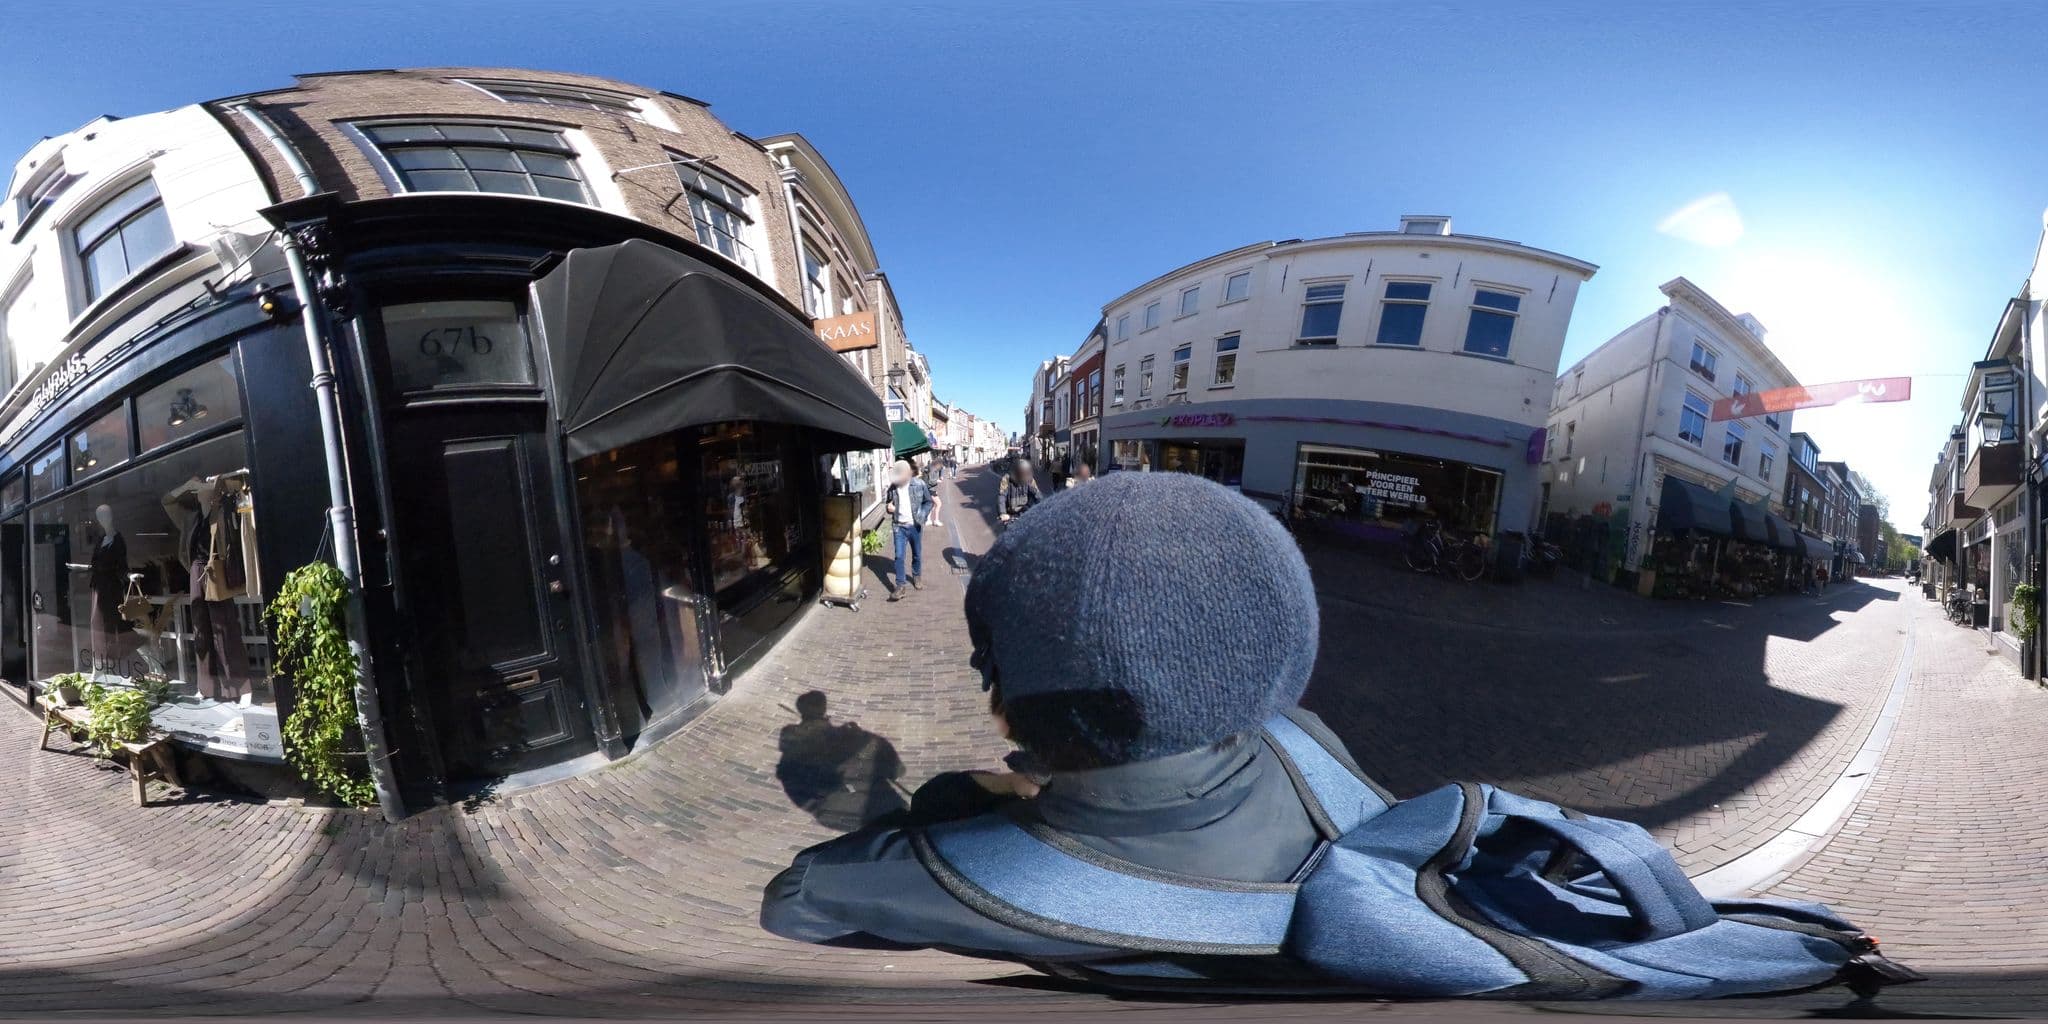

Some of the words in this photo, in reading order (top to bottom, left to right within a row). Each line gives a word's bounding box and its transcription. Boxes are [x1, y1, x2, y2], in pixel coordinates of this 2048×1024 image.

[420, 325, 493, 356] 67b
[820, 321, 871, 342] KAAS
[1366, 470, 1420, 486] PRINCIPIEEL
[1370, 479, 1395, 491] VOOR
[1395, 483, 1414, 493] EEN
[1389, 490, 1427, 503] WERELD
[80, 648, 145, 682] GURUS
